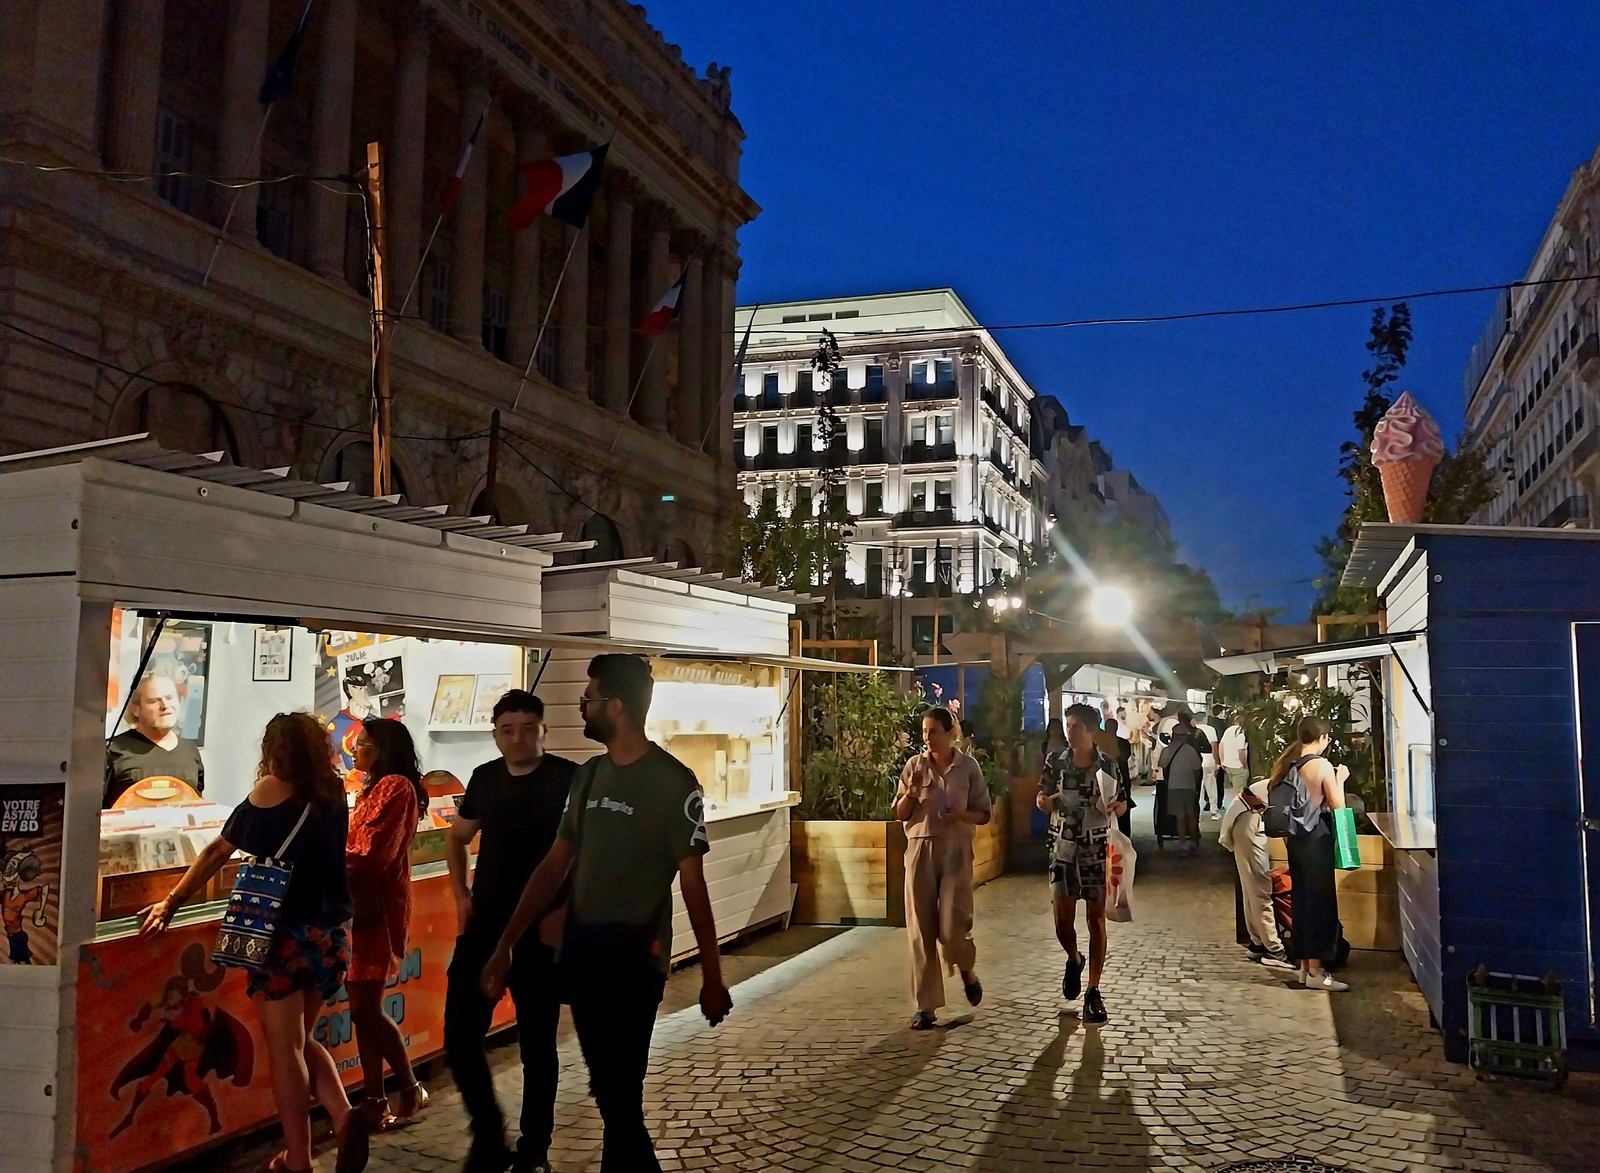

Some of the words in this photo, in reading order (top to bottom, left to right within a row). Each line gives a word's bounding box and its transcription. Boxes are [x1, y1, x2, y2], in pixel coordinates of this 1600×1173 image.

[344, 651, 367, 663] JULIE
[3, 799, 41, 811] VOTRE
[2, 809, 38, 820] ASTRO
[1, 820, 18, 832] EN
[19, 820, 39, 832] BD
